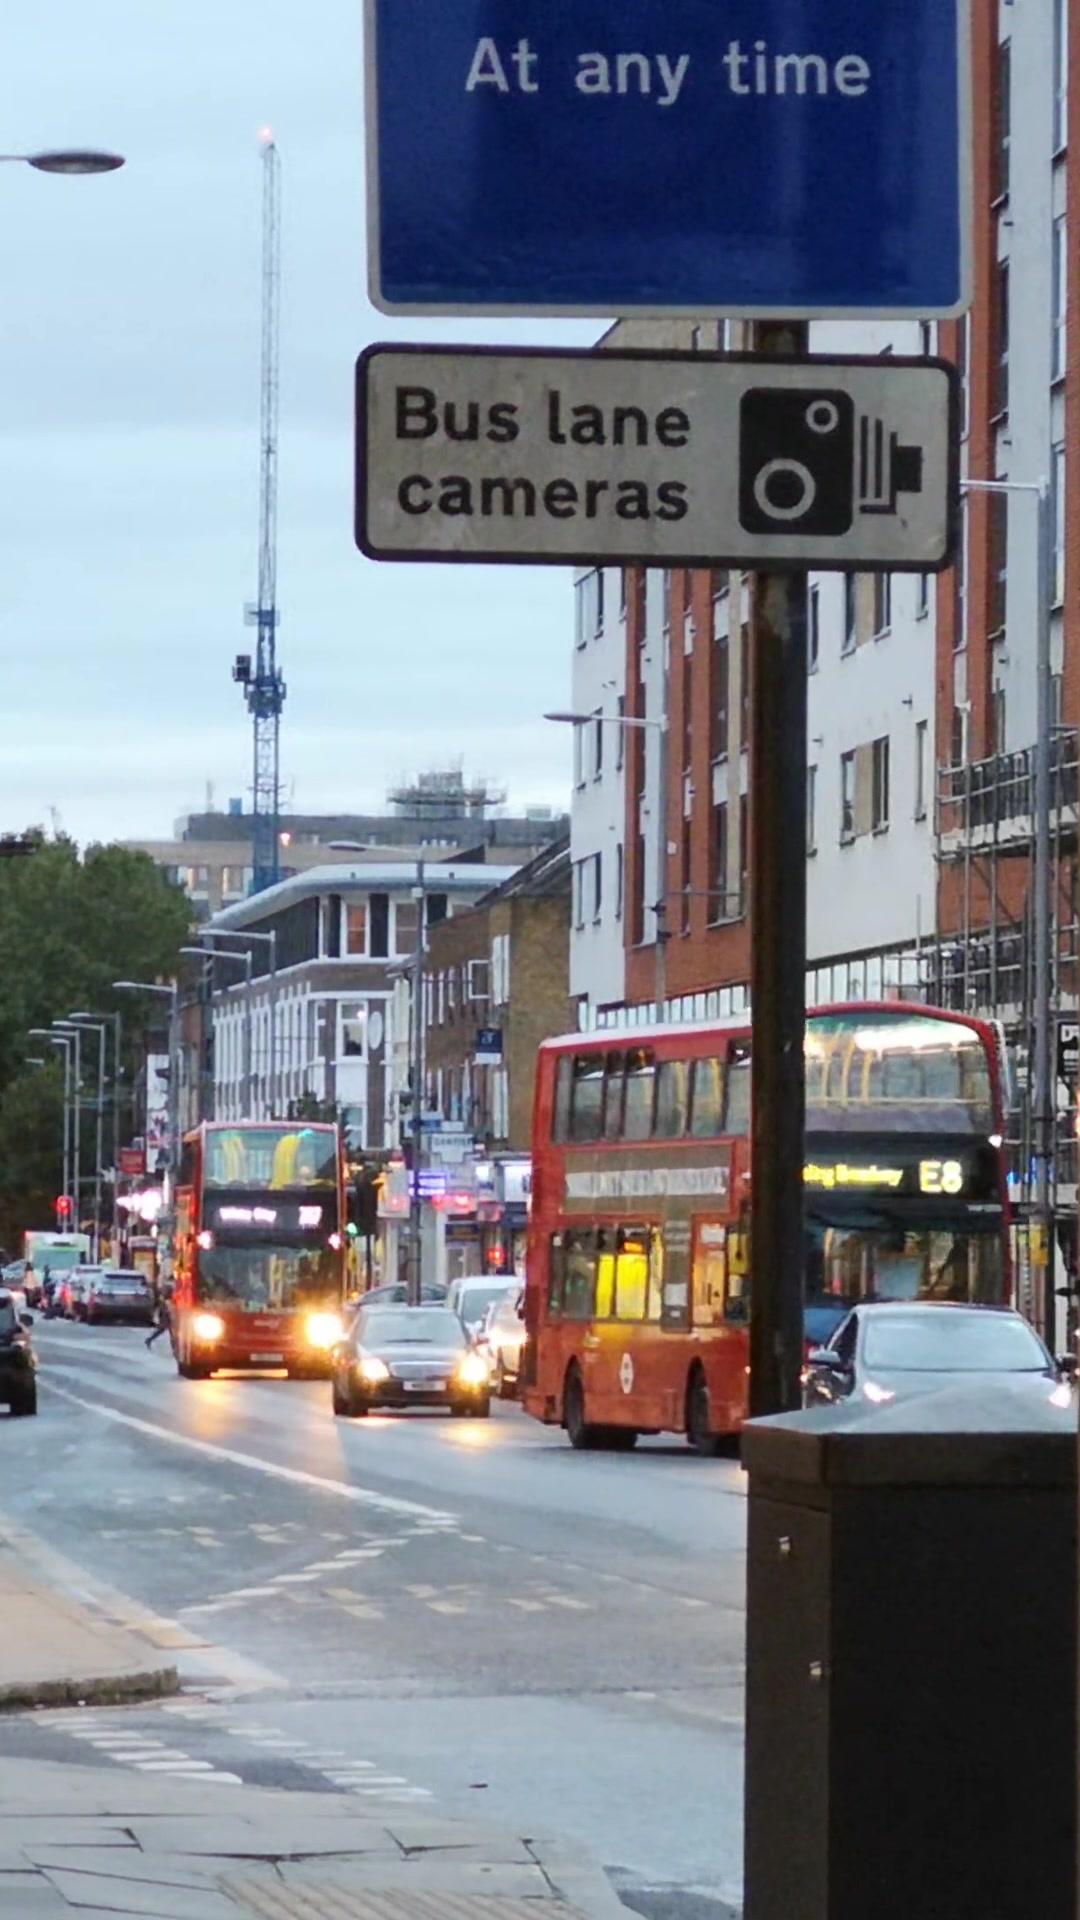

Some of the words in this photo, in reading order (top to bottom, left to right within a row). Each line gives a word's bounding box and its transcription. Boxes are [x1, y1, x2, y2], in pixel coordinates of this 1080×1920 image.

[465, 37, 539, 94] At
[575, 53, 690, 106] any
[722, 40, 871, 97] time
[393, 384, 521, 447] Bus
[547, 389, 692, 448] lane
[396, 473, 689, 521] cameras
[918, 1159, 964, 1194] E8
